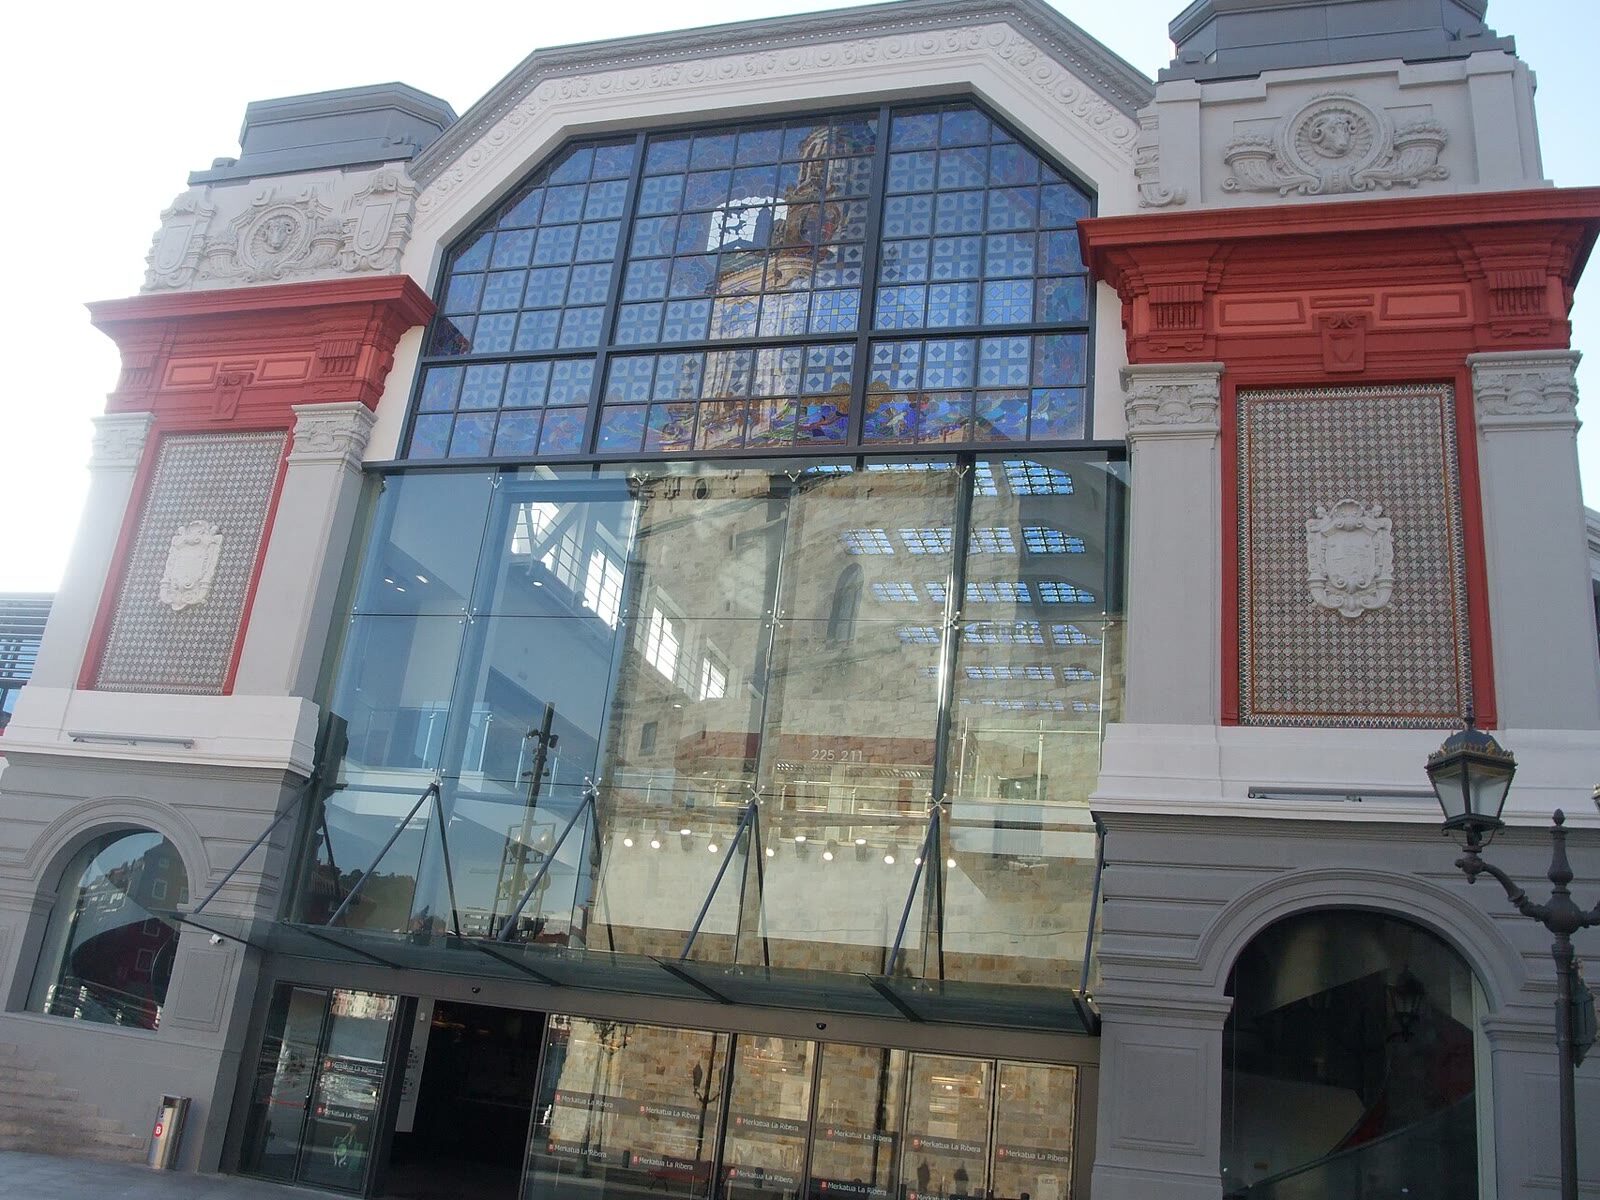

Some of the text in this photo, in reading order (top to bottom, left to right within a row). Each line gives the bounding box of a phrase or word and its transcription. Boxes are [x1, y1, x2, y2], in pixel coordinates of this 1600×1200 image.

[811, 750, 862, 762] 225 211
[646, 1106, 672, 1116] Merkatua
[682, 1111, 700, 1120] Ribera
[743, 1118, 770, 1128] Merkatua
[780, 1122, 799, 1132] Ribera
[834, 1129, 862, 1139] Merkatua
[872, 1134, 892, 1143] Ribera
[555, 1144, 580, 1154] Merkatua
[589, 1150, 608, 1158] Ribera
[920, 1140, 950, 1150] Merkatua
[960, 1144, 981, 1153] Ribera
[639, 1156, 665, 1167] Merkatua
[666, 1160, 674, 1168] La
[675, 1162, 694, 1170] Ribera
[1006, 1150, 1036, 1159] Merkatua
[1048, 1154, 1068, 1163] Ribera
[737, 1170, 764, 1180] Merkatua
[774, 1174, 794, 1184] Ribera
[828, 1182, 856, 1192] Merkatua
[858, 1186, 865, 1194] La
[867, 1187, 887, 1196] Ribera
